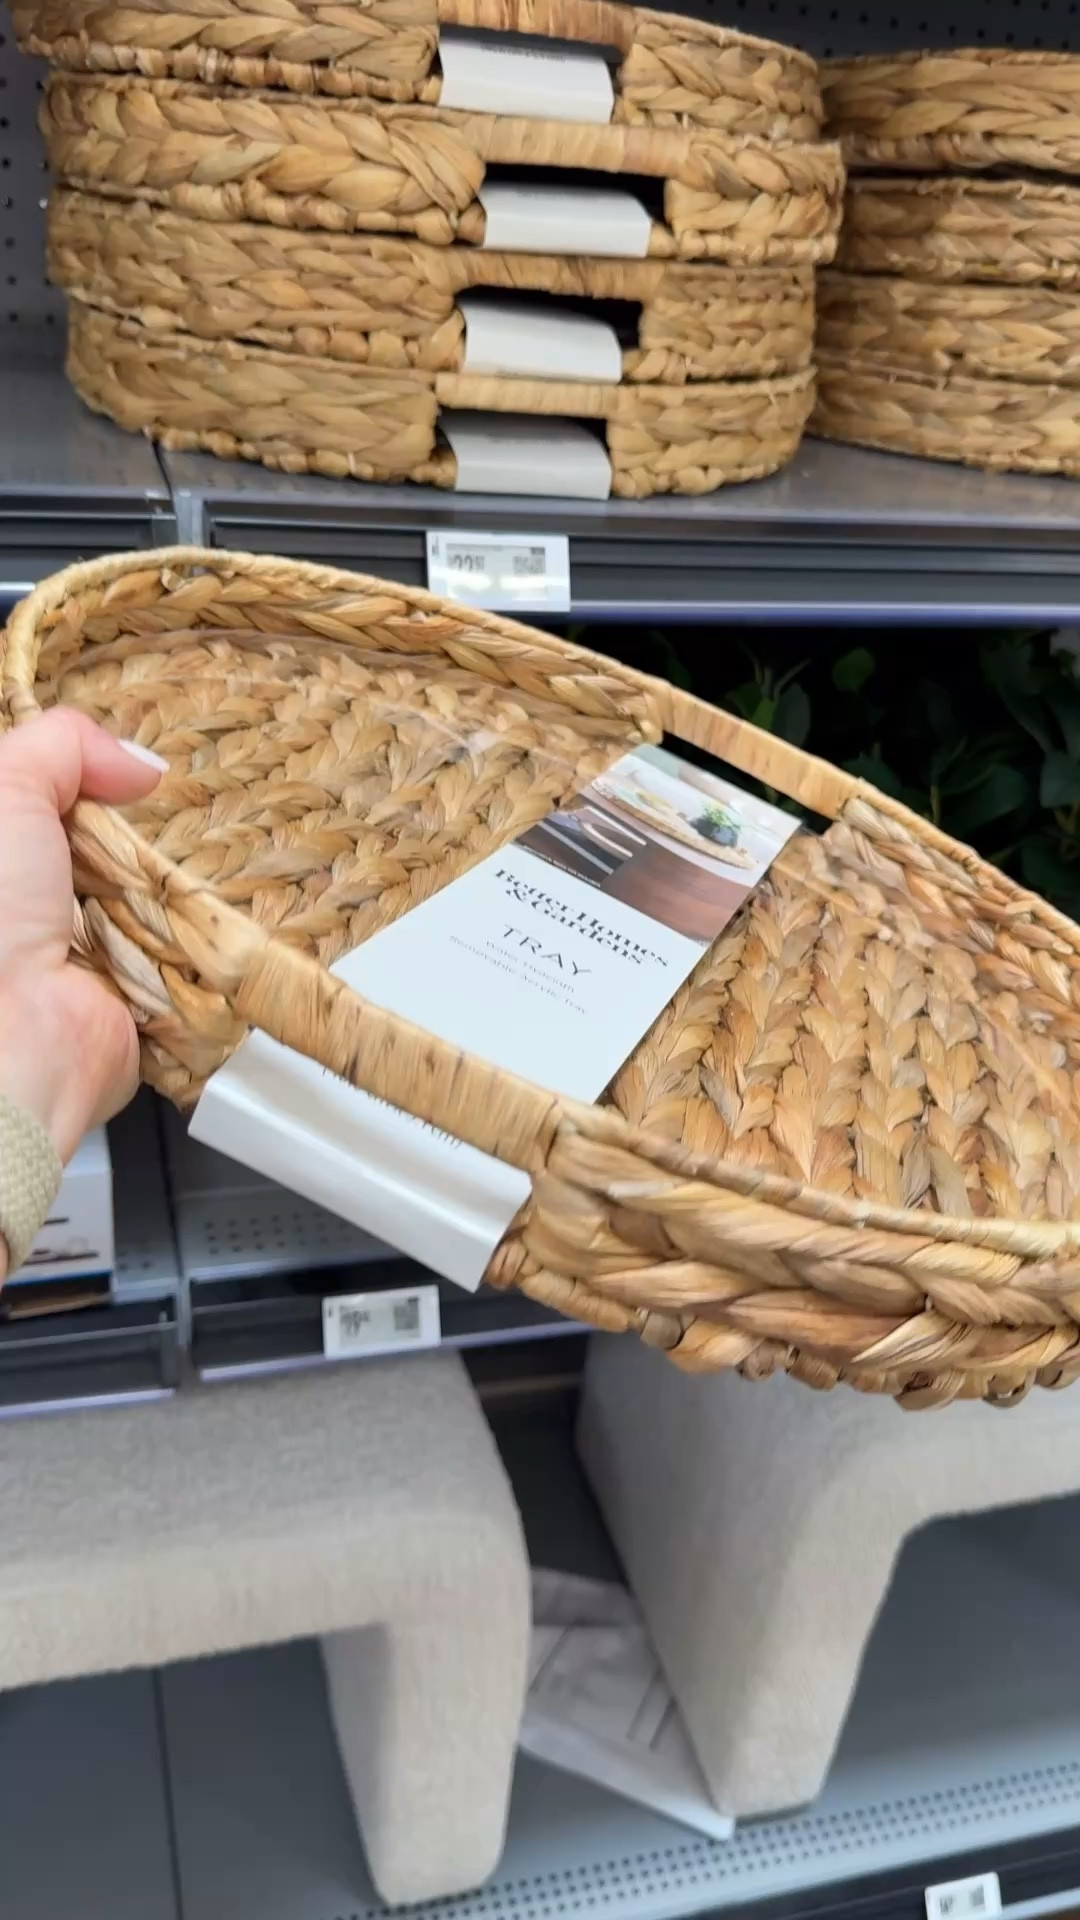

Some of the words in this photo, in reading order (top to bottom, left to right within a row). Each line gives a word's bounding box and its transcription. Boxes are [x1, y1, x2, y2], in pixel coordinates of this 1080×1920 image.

[495, 869, 574, 913] Better
[577, 911, 668, 967] Homes
[503, 923, 592, 976] TRAY
[505, 888, 527, 903] &
[531, 900, 642, 965] Gardens
